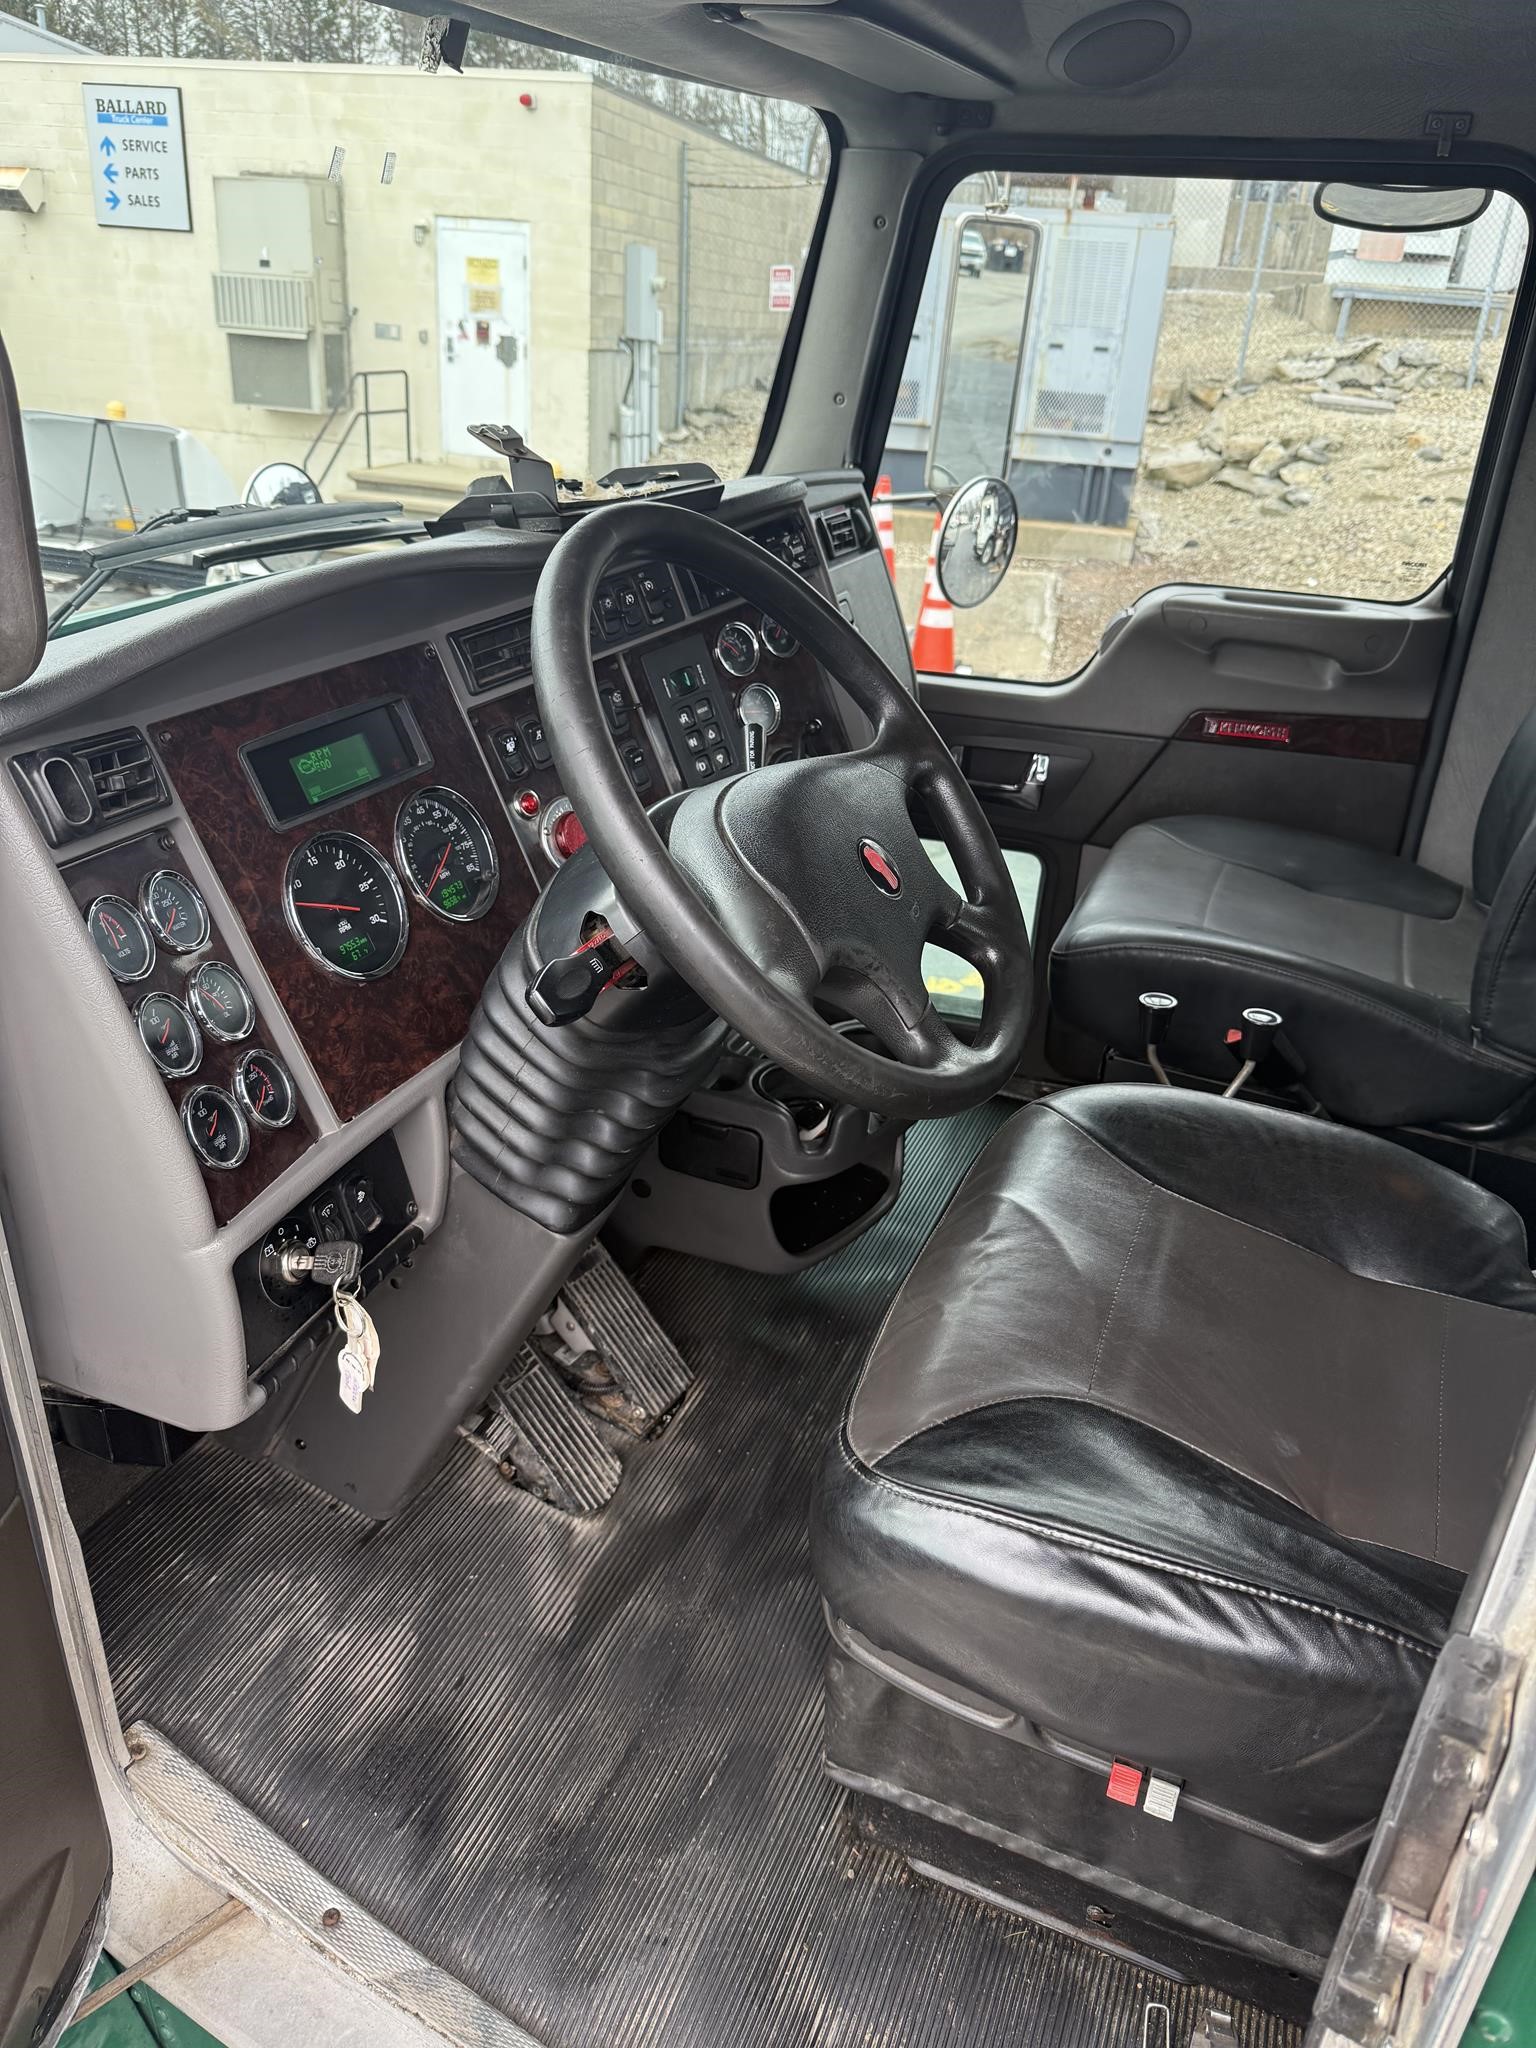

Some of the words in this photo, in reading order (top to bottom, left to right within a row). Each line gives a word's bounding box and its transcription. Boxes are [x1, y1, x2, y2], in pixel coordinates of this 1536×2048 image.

[95, 98, 167, 116] BALLARD
[122, 139, 168, 153] SERVICE
[125, 166, 160, 180] PARTS
[128, 194, 160, 208] SALES
[310, 745, 332, 761] RPM
[416, 806, 425, 815] 45
[432, 810, 442, 820] 55
[307, 856, 319, 866] 15
[334, 859, 346, 870] 20
[466, 863, 475, 872] 85
[358, 881, 370, 892] 25
[369, 914, 380, 925] 30
[338, 922, 352, 934] RPM
